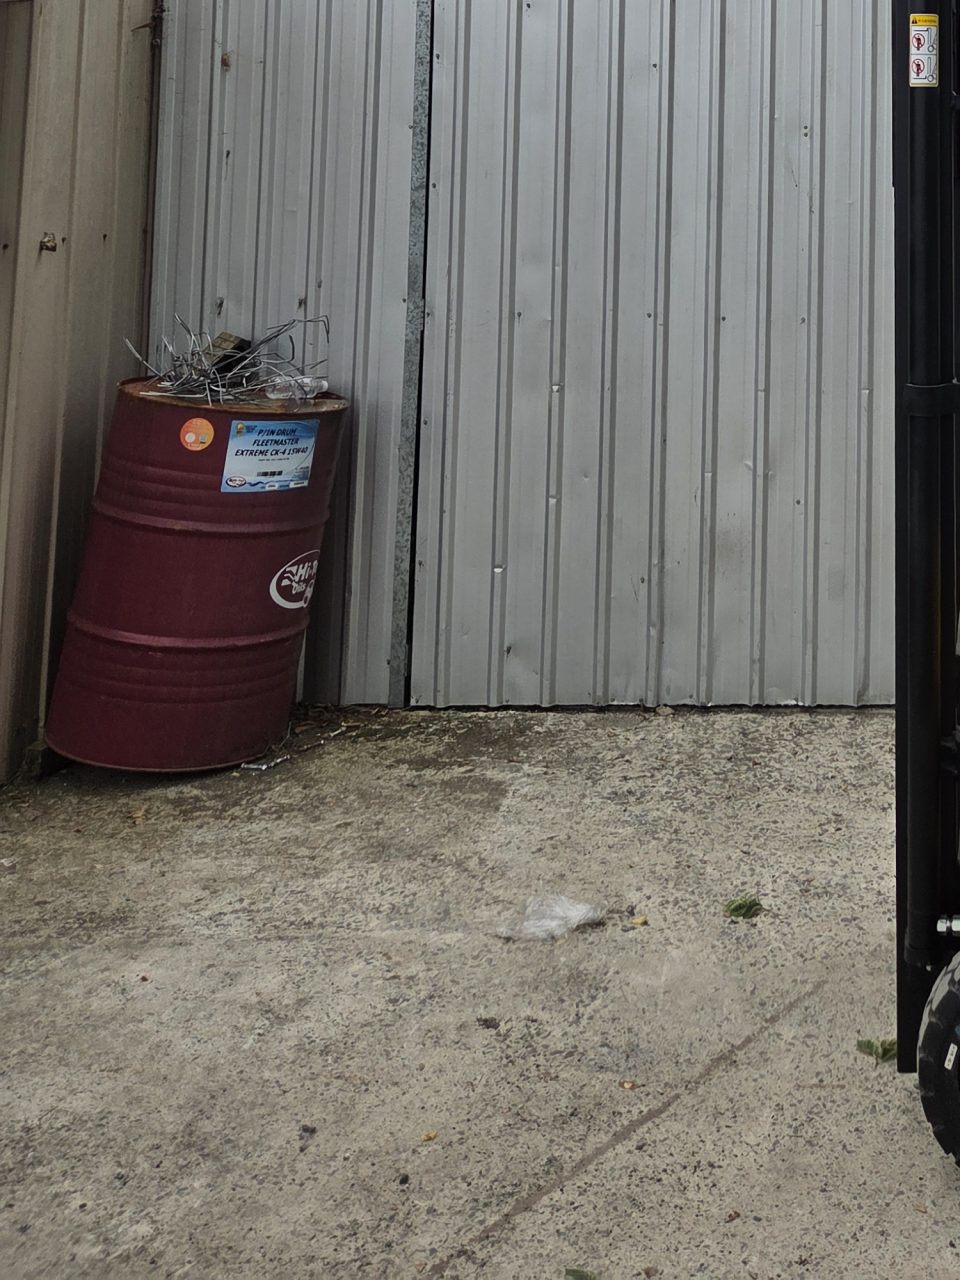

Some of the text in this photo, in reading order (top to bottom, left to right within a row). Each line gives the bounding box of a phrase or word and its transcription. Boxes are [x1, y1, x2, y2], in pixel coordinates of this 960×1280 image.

[276, 428, 298, 436] DRUM
[252, 438, 300, 447] FLEETMASTER
[234, 446, 309, 457] EXTREME CK-4 15W40
